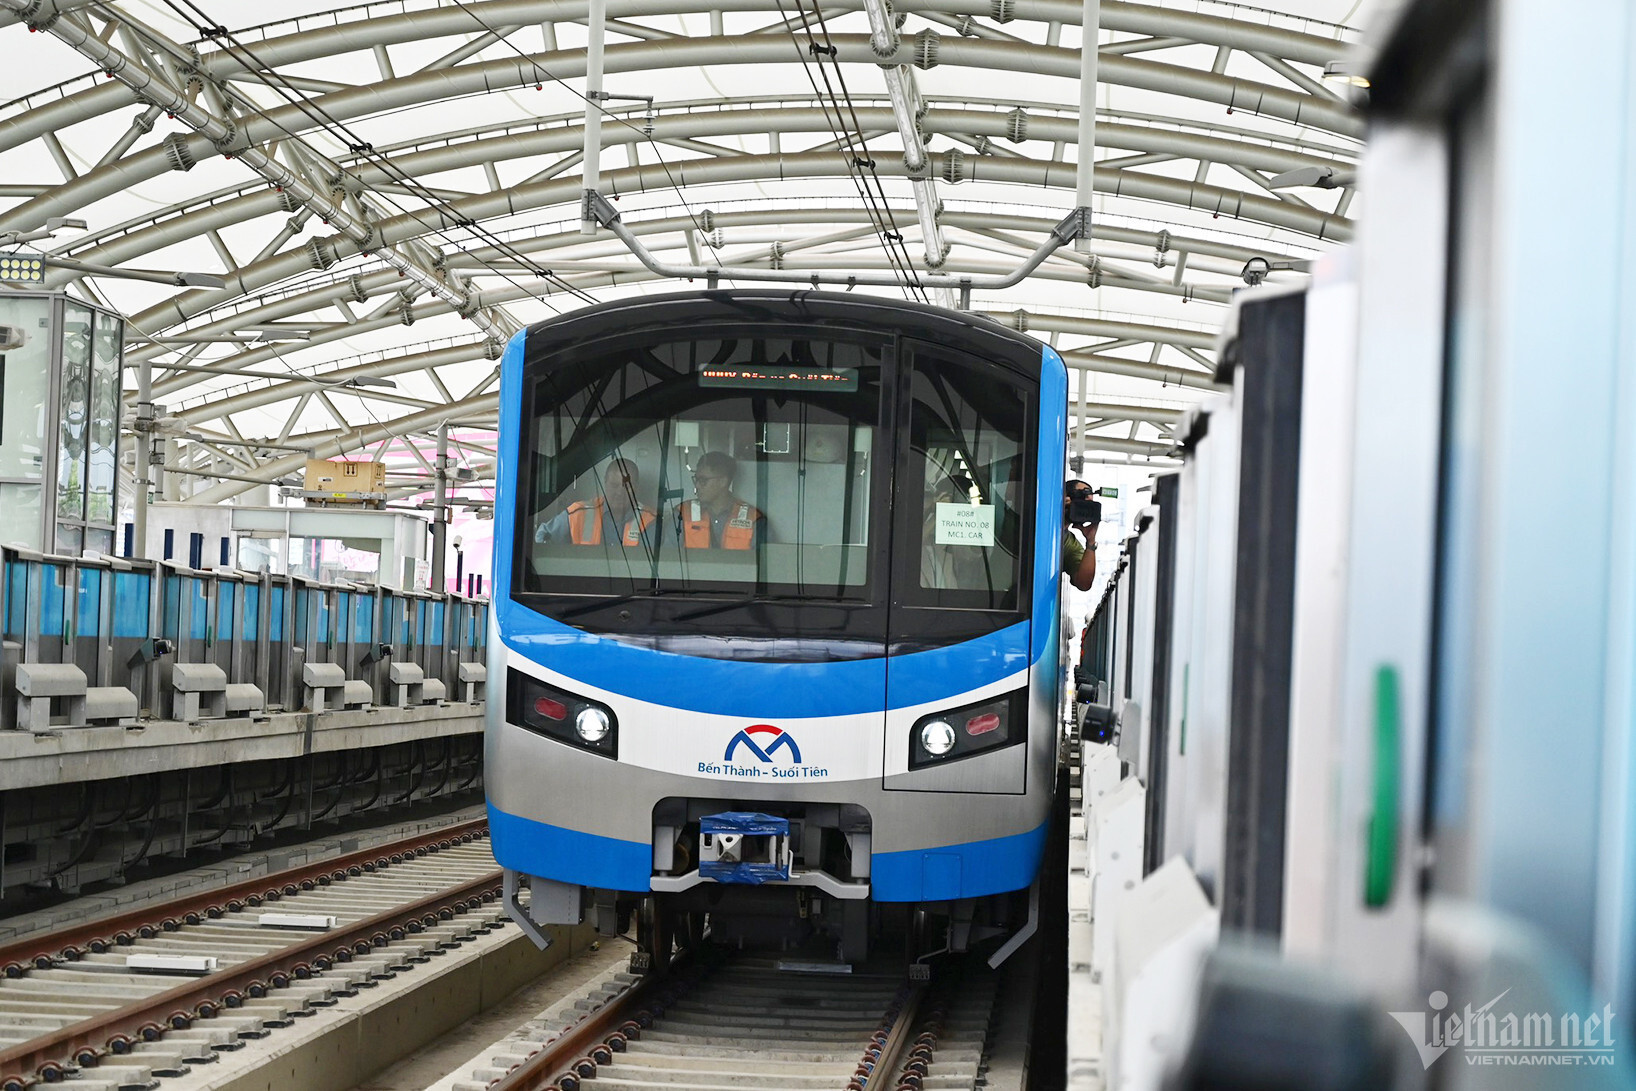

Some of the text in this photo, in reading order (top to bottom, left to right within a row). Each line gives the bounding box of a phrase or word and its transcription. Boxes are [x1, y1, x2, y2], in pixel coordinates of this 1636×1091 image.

[968, 531, 983, 539] CAR
[698, 762, 720, 774] Bến
[722, 765, 761, 777] Thành
[771, 766, 799, 777] Suối
[801, 767, 828, 777] Tiên
